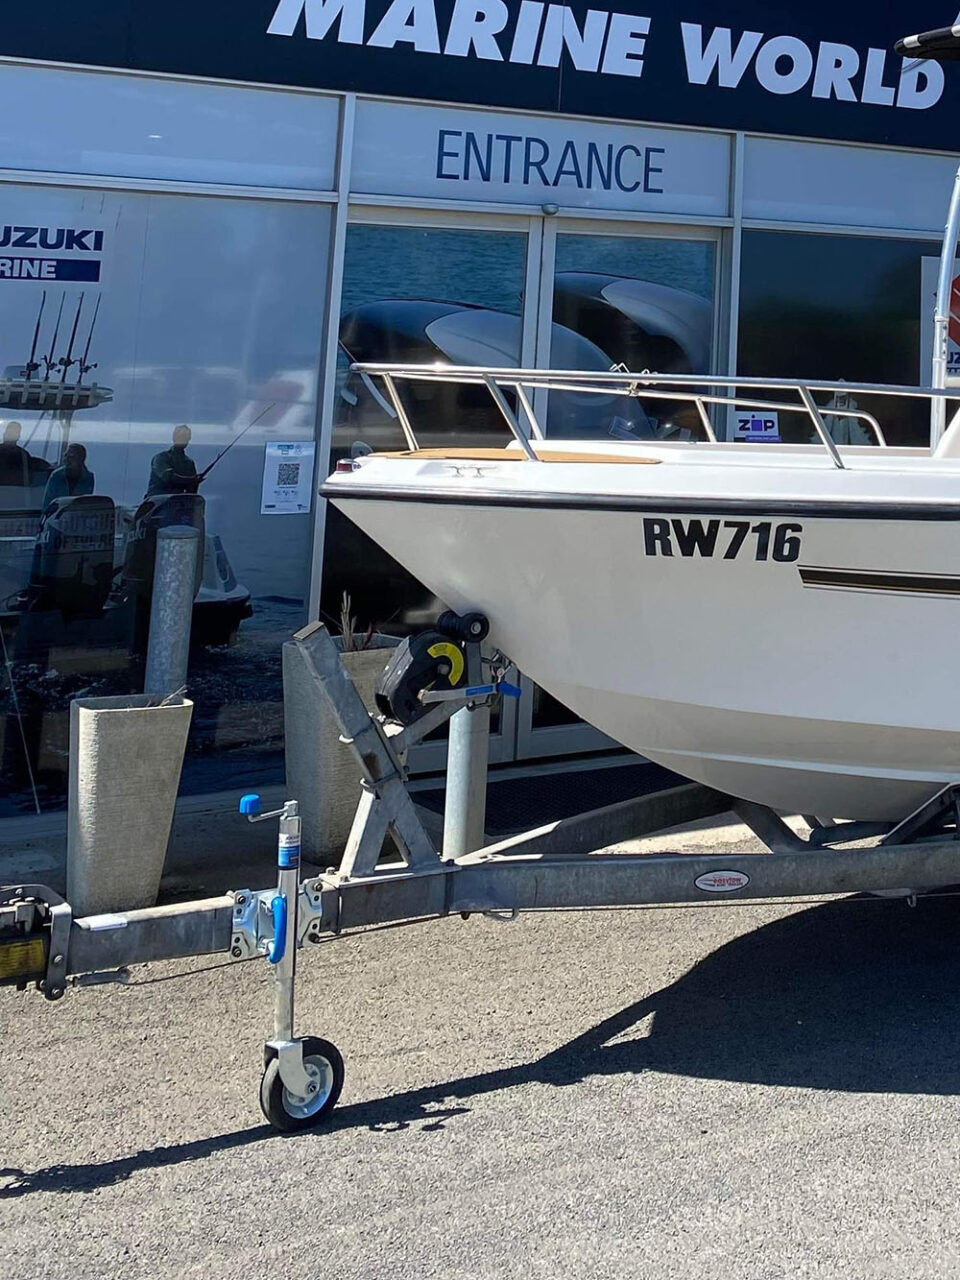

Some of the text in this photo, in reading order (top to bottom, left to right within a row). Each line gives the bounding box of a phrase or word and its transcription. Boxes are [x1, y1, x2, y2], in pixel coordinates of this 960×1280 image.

[680, 22, 945, 110] WORLD
[436, 130, 665, 193] ENTRANCE
[642, 517, 802, 562] RW716
